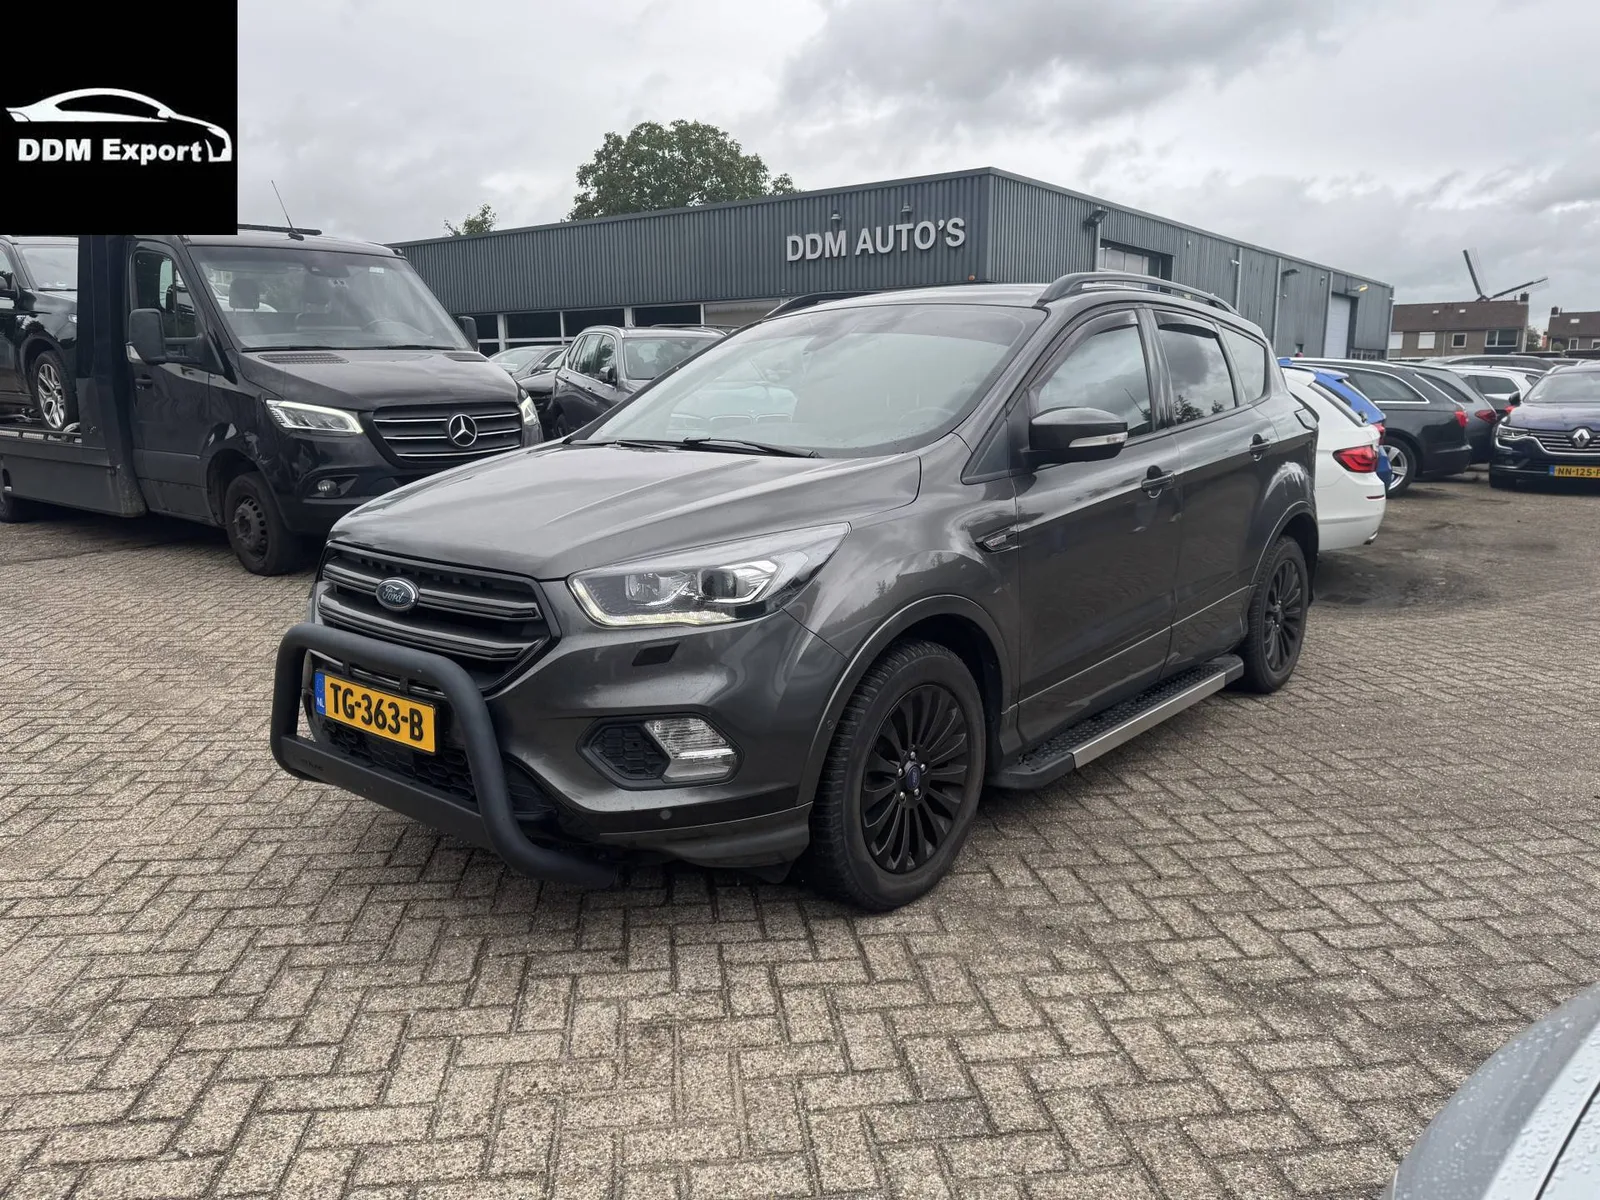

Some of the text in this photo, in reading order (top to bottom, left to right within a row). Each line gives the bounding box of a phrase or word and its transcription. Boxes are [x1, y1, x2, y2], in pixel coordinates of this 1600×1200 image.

[786, 217, 965, 262] DDM AUTO'S
[330, 682, 424, 742] TG-363-B
